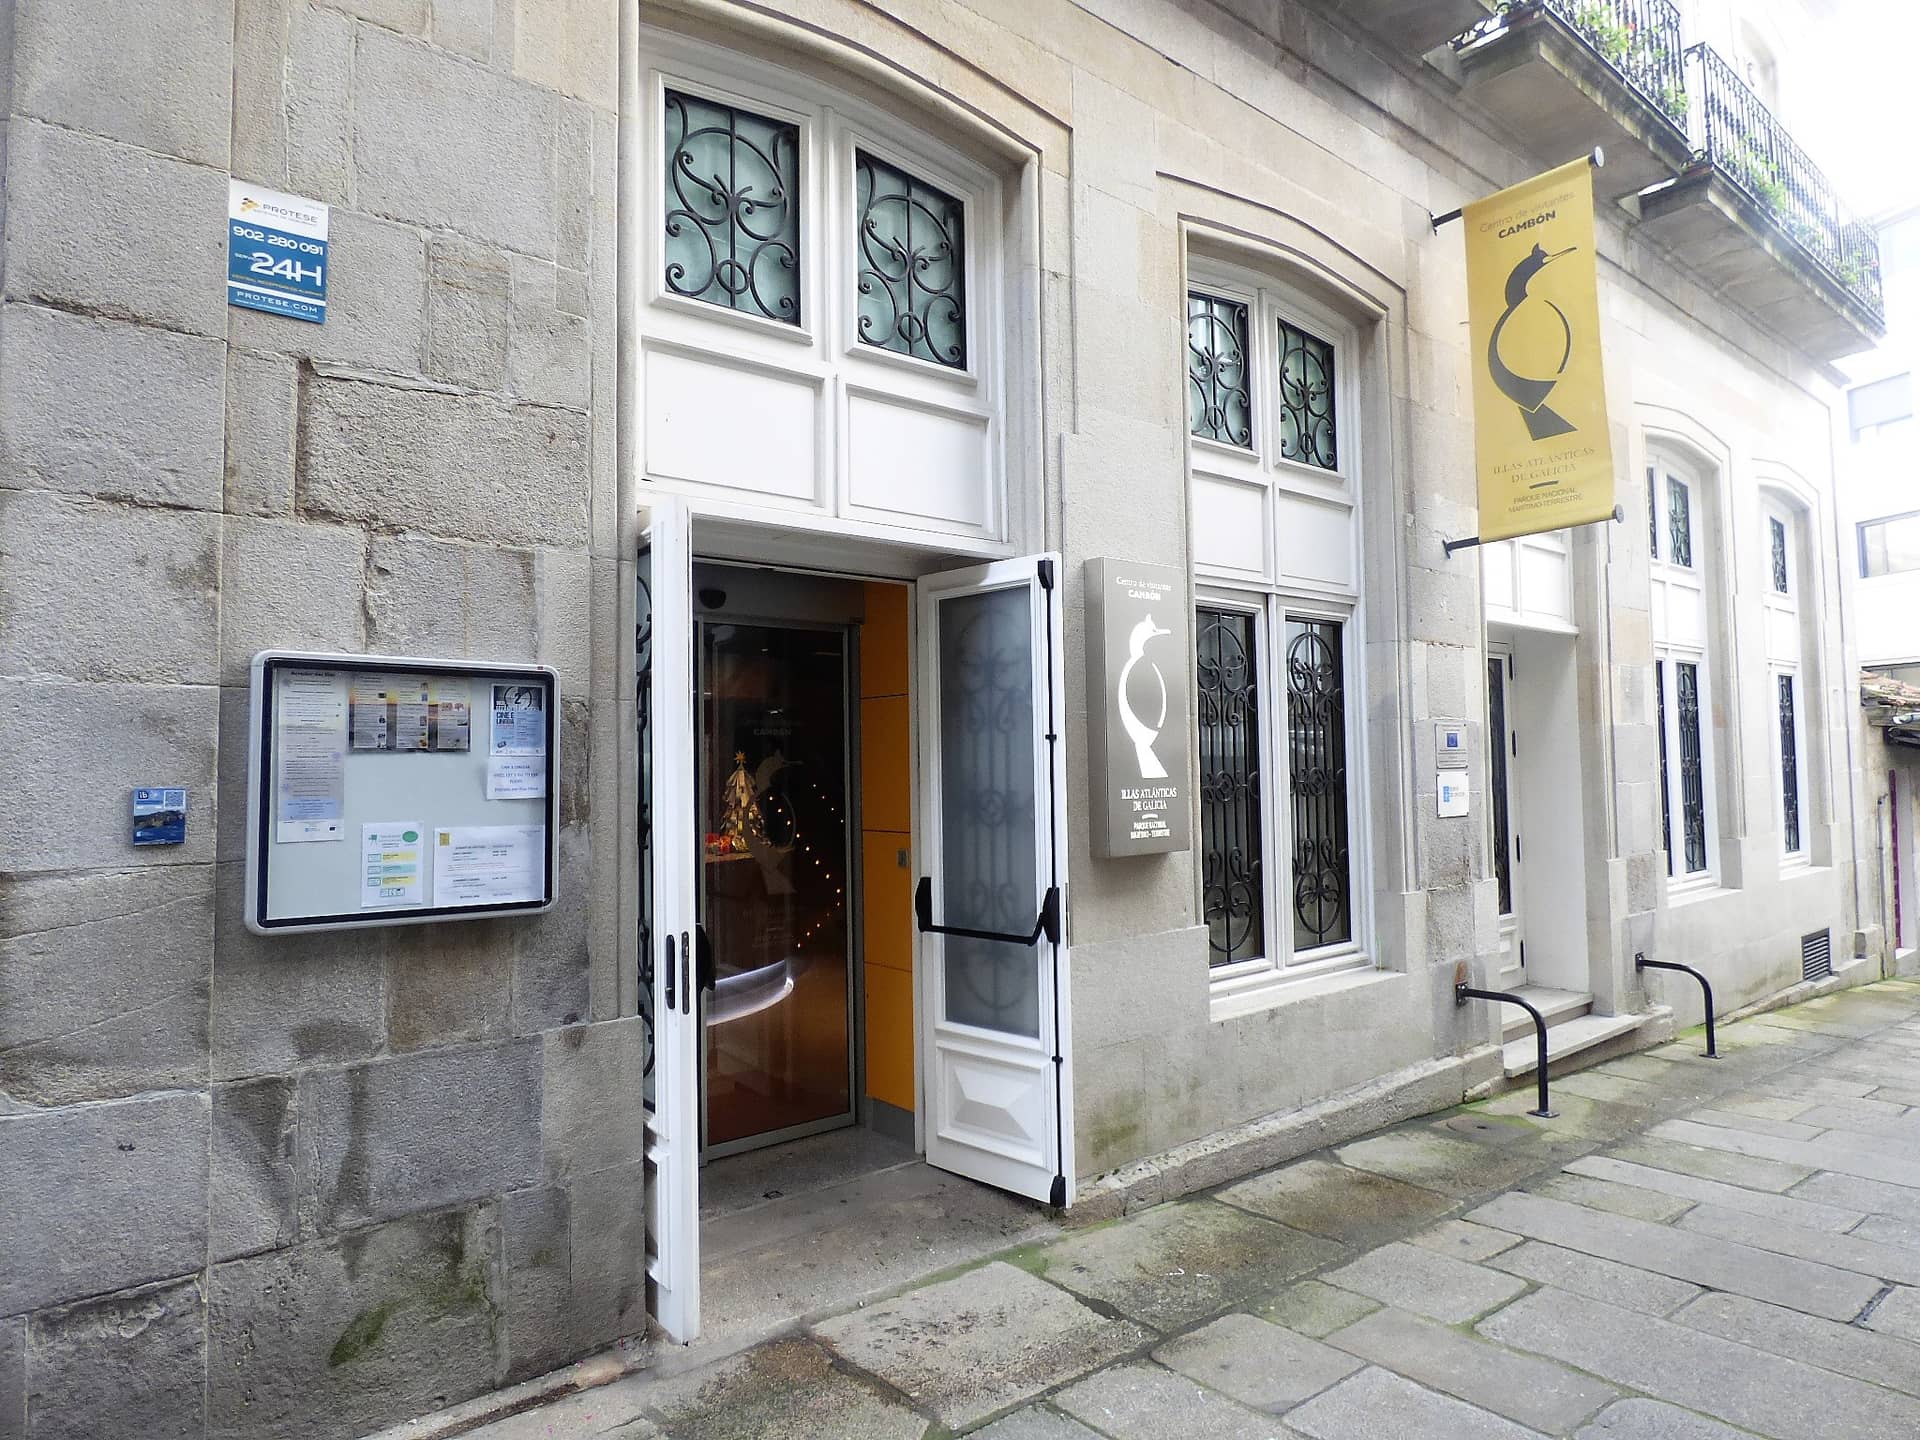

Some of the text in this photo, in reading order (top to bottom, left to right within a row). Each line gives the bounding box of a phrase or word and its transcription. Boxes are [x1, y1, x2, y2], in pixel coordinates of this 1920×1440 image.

[263, 204, 319, 223] PROTESE
[1498, 210, 1556, 239] CAMBÓN
[233, 226, 324, 256] 902 280 091
[250, 251, 322, 287] 24H
[236, 290, 318, 313] PROTESE.COM
[1121, 788, 1140, 800] ILLAS
[1133, 799, 1168, 812] DE GALICIA
